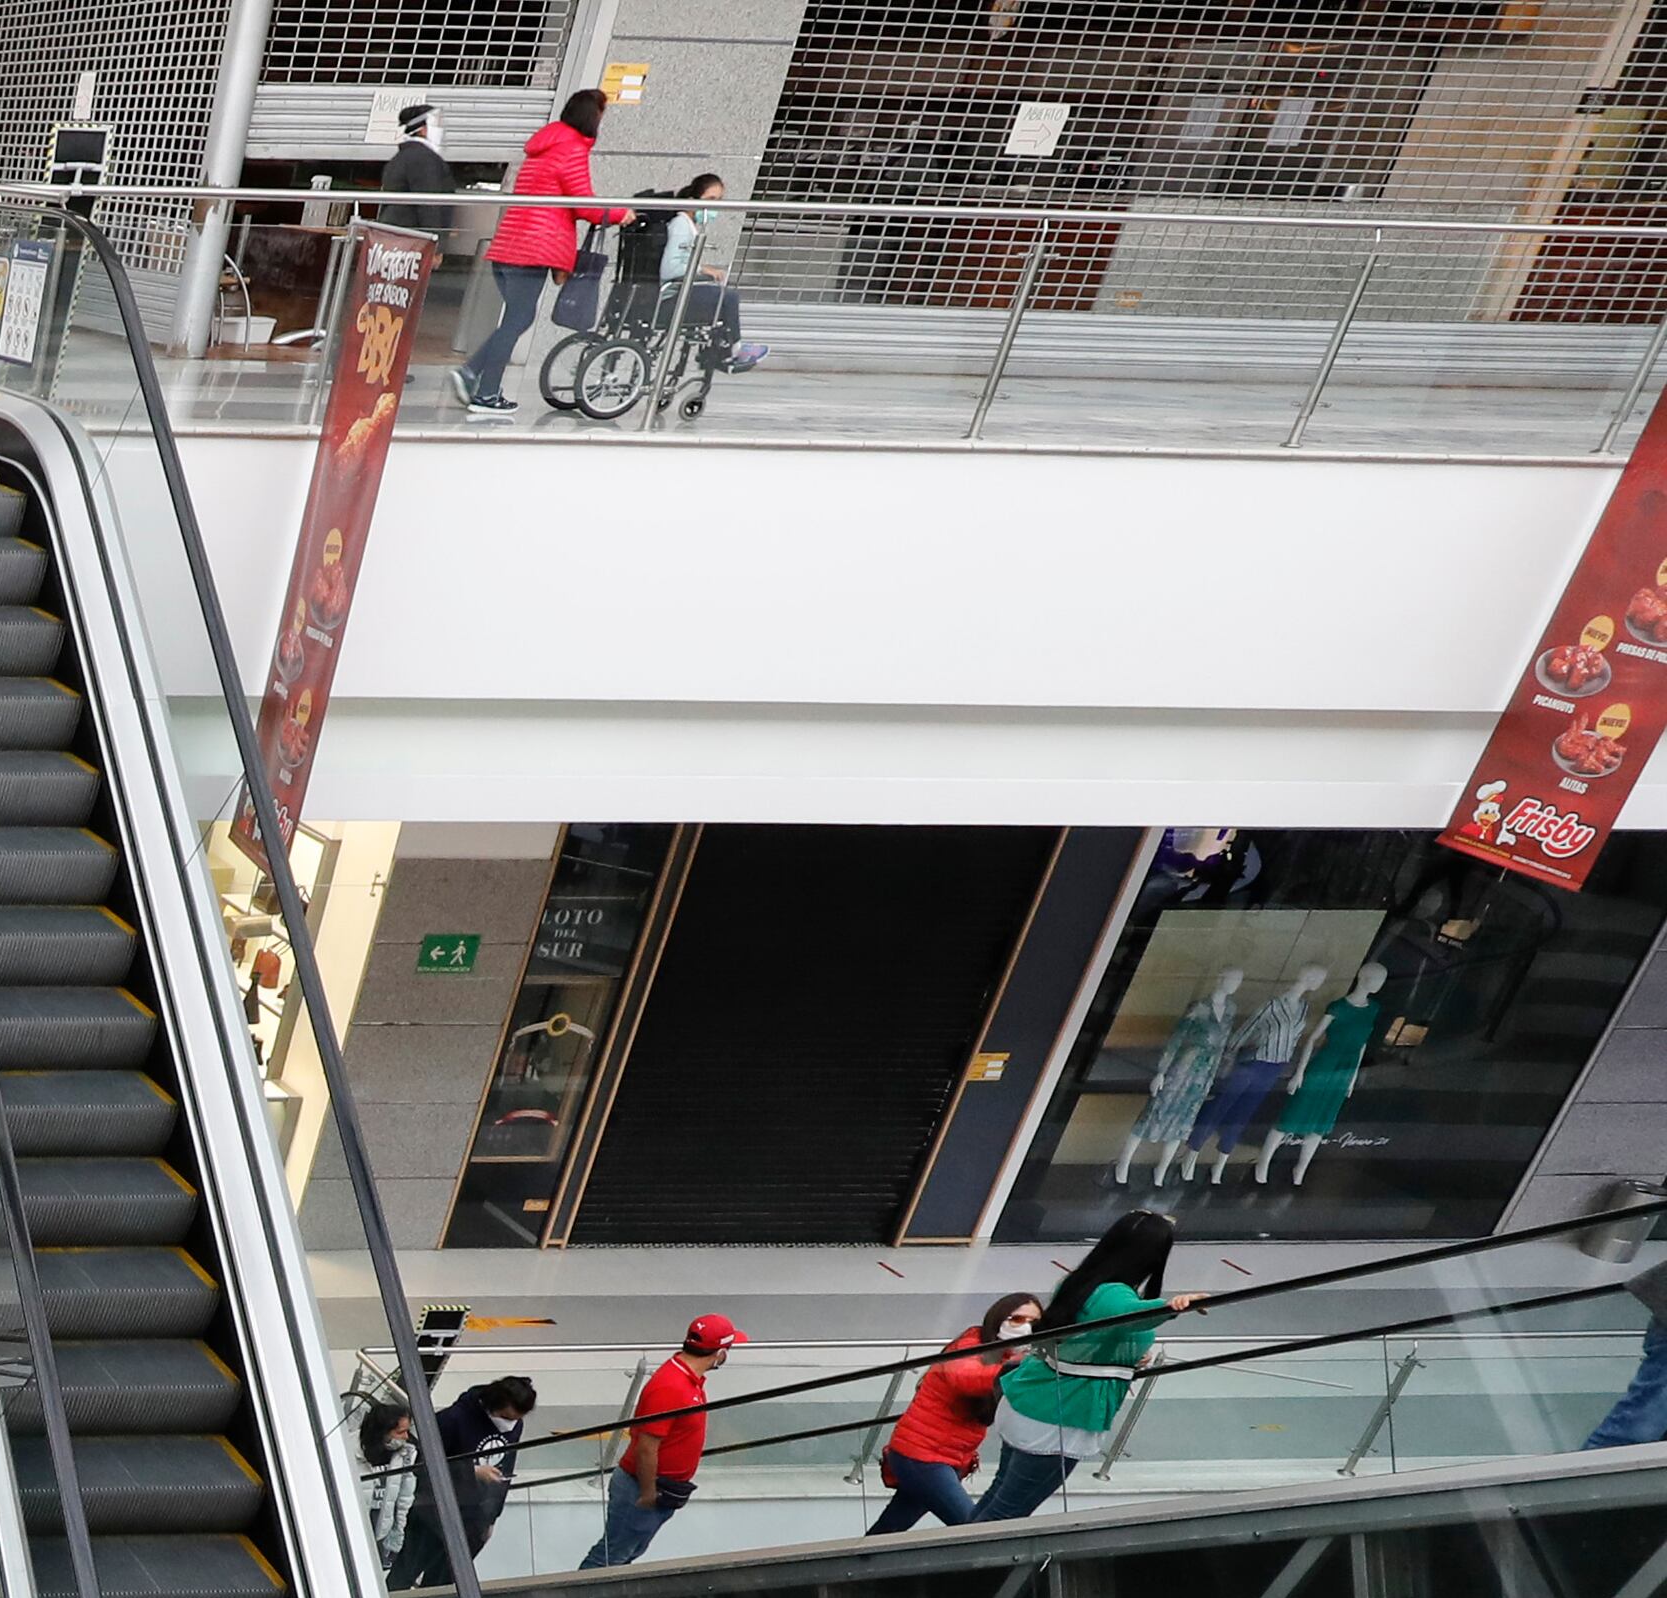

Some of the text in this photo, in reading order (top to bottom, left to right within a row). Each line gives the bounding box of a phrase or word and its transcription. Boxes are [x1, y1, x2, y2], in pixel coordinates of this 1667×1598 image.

[357, 306, 403, 386] BBQ
[1559, 777, 1588, 795] ALITAS
[1504, 799, 1594, 858] Frisby
[554, 929, 578, 939] DEL
[537, 942, 584, 958] SUR
